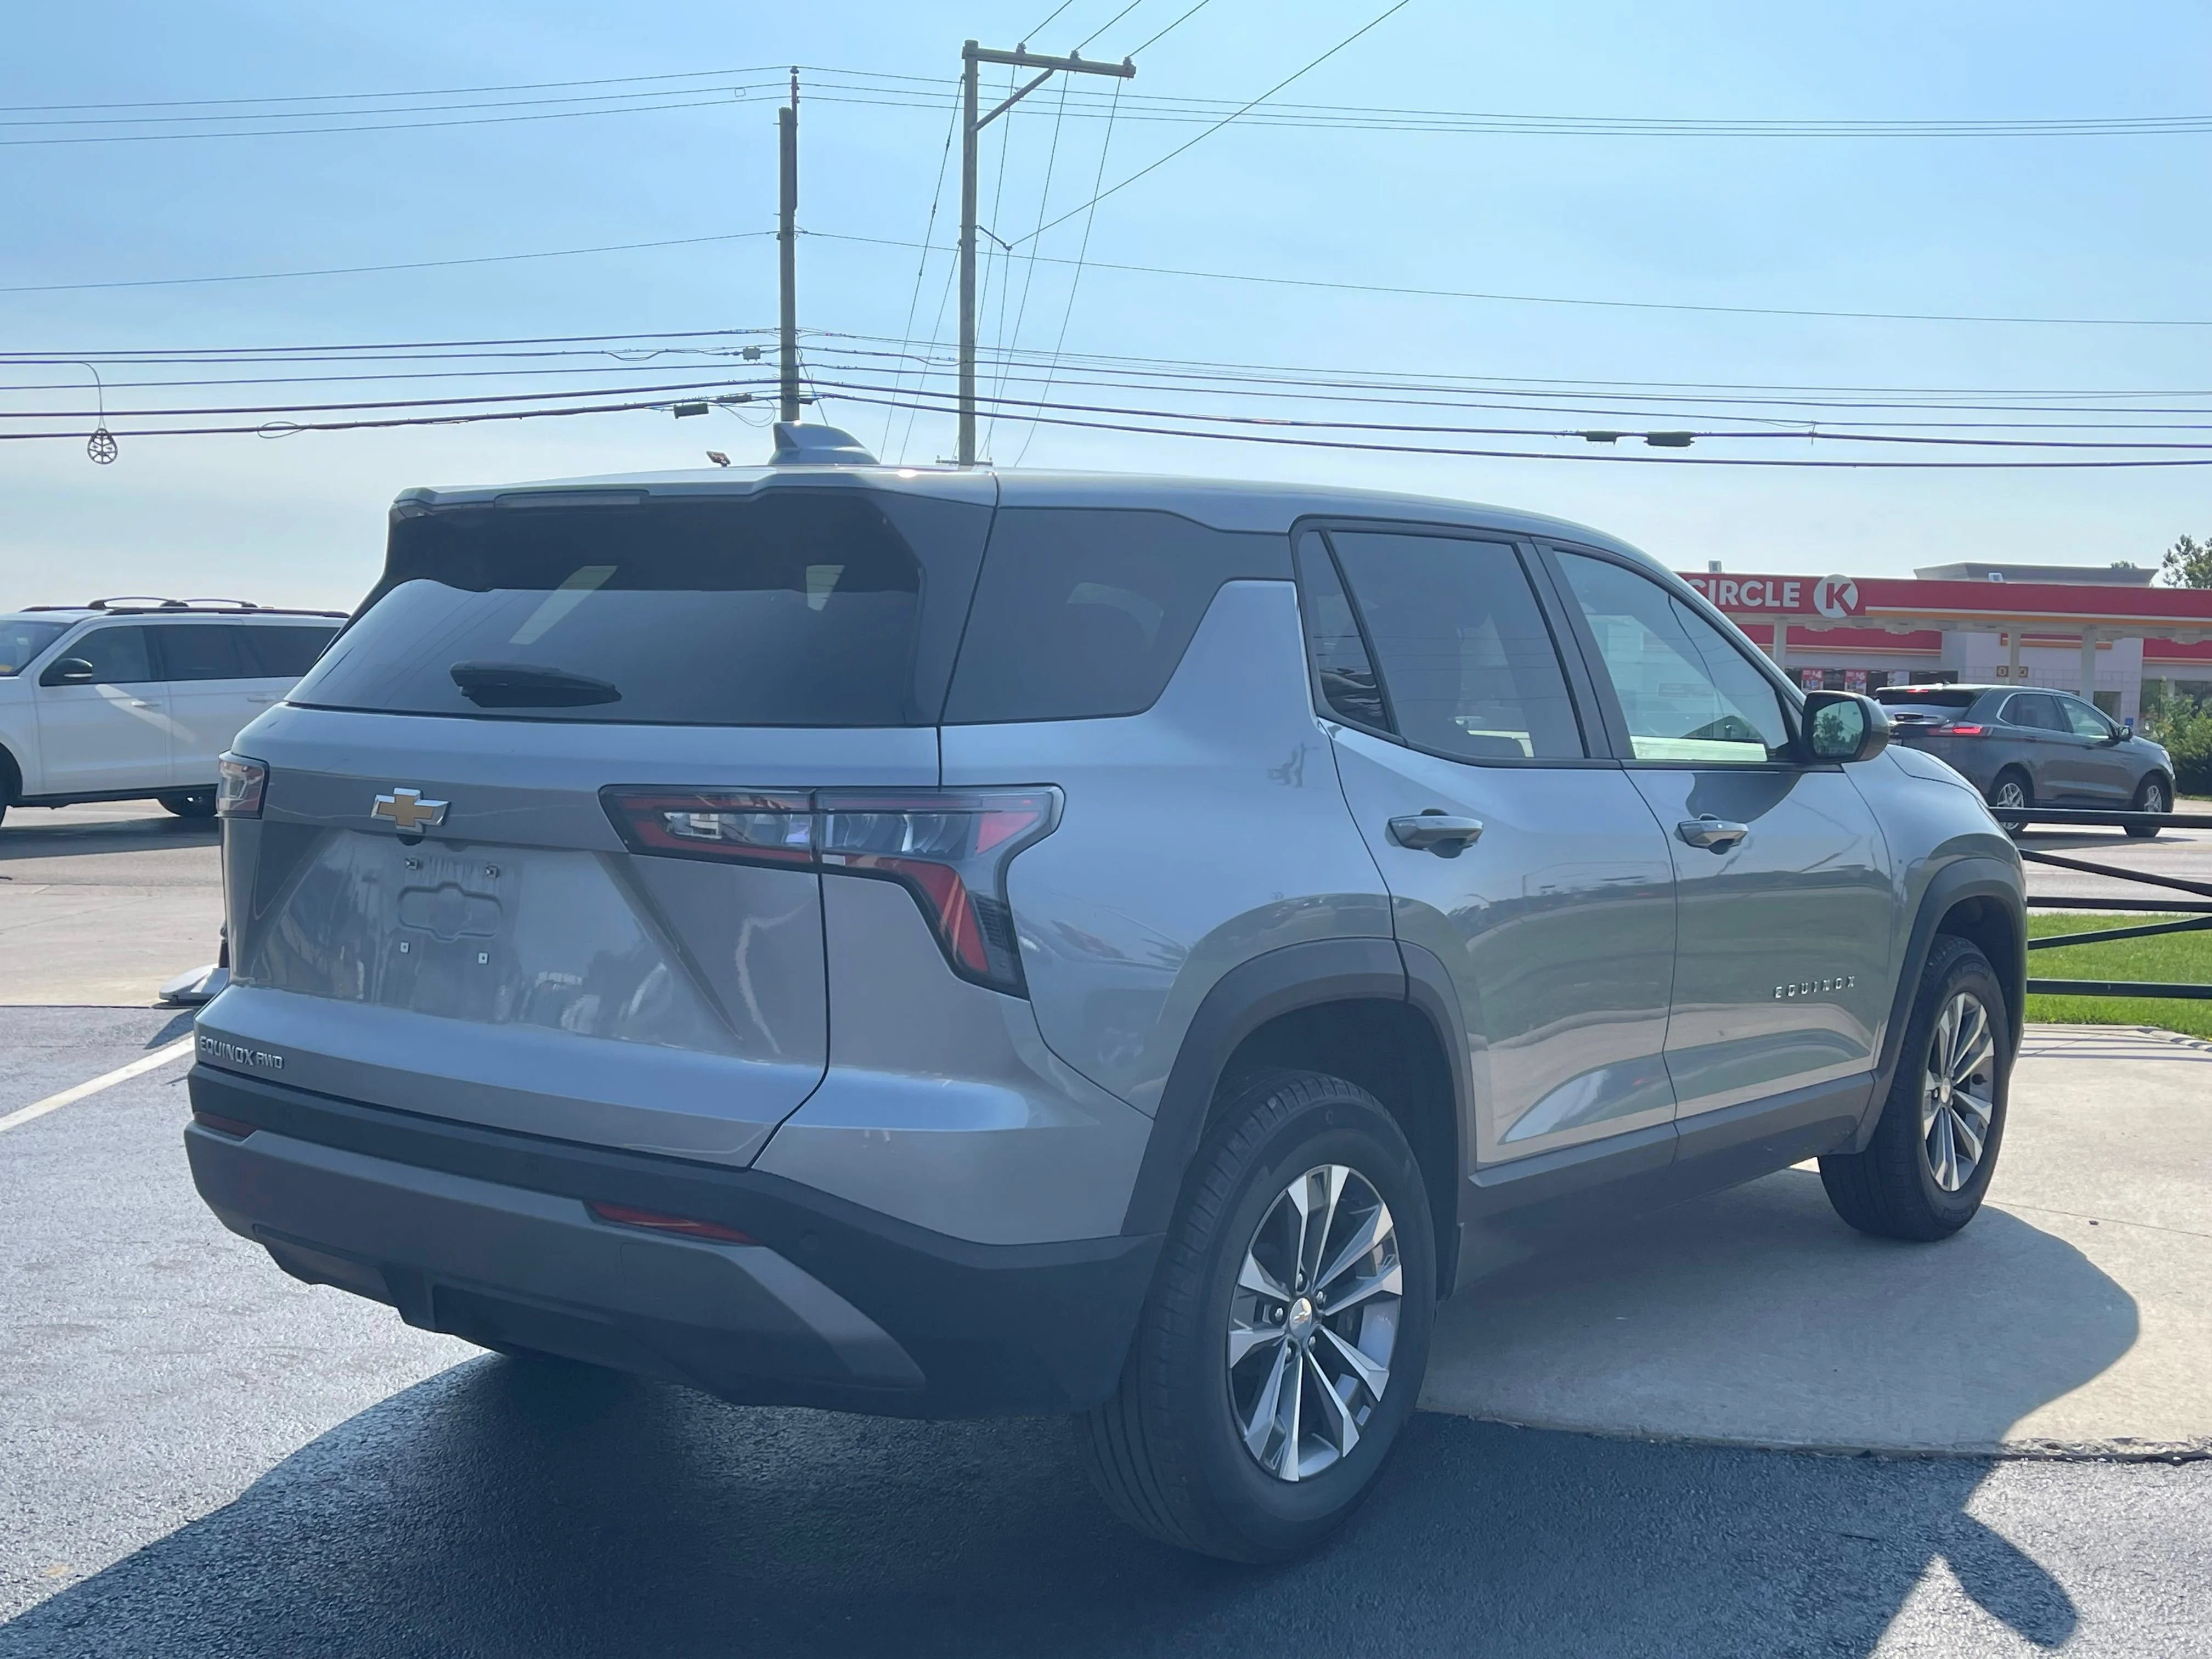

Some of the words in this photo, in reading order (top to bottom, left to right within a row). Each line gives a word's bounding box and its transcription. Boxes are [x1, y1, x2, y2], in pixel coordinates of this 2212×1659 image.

[1824, 582, 1855, 614] K
[1775, 975, 1855, 998] EQUINOX
[199, 1036, 255, 1066] EQUINOX
[256, 1051, 284, 1069] AWD
